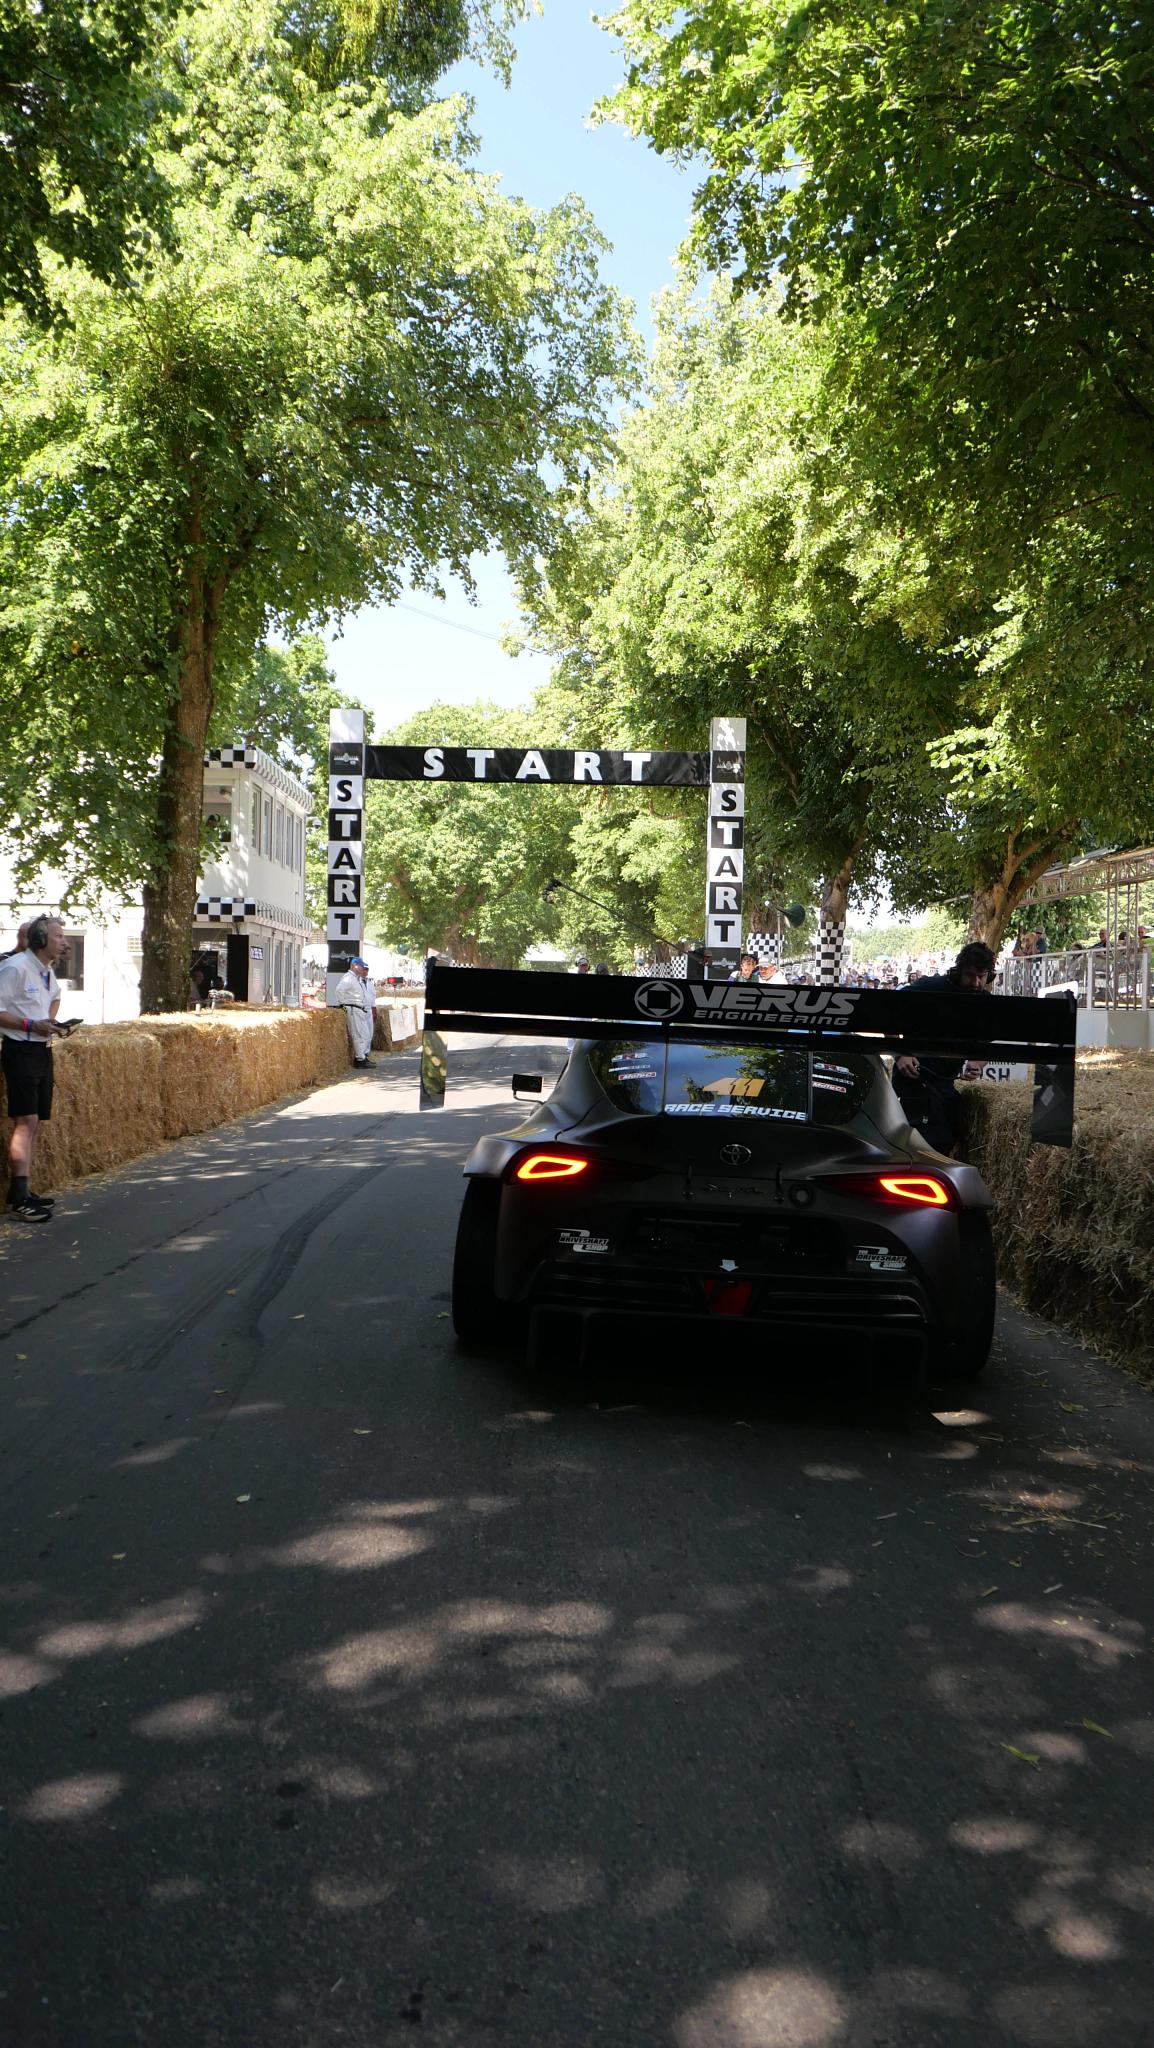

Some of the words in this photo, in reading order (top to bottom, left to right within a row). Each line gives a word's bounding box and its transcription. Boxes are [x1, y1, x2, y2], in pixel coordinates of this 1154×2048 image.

[423, 748, 651, 782] START
[333, 779, 358, 936] START
[714, 789, 739, 943] START
[688, 984, 861, 1015] VERUS
[693, 1009, 849, 1026] ENGINEERING
[664, 1103, 715, 1113] RACE
[717, 1104, 807, 1121] SERVICE
[558, 1236, 610, 1245] DRIVESHAFT
[855, 1254, 908, 1264] DRIVESHAFT
